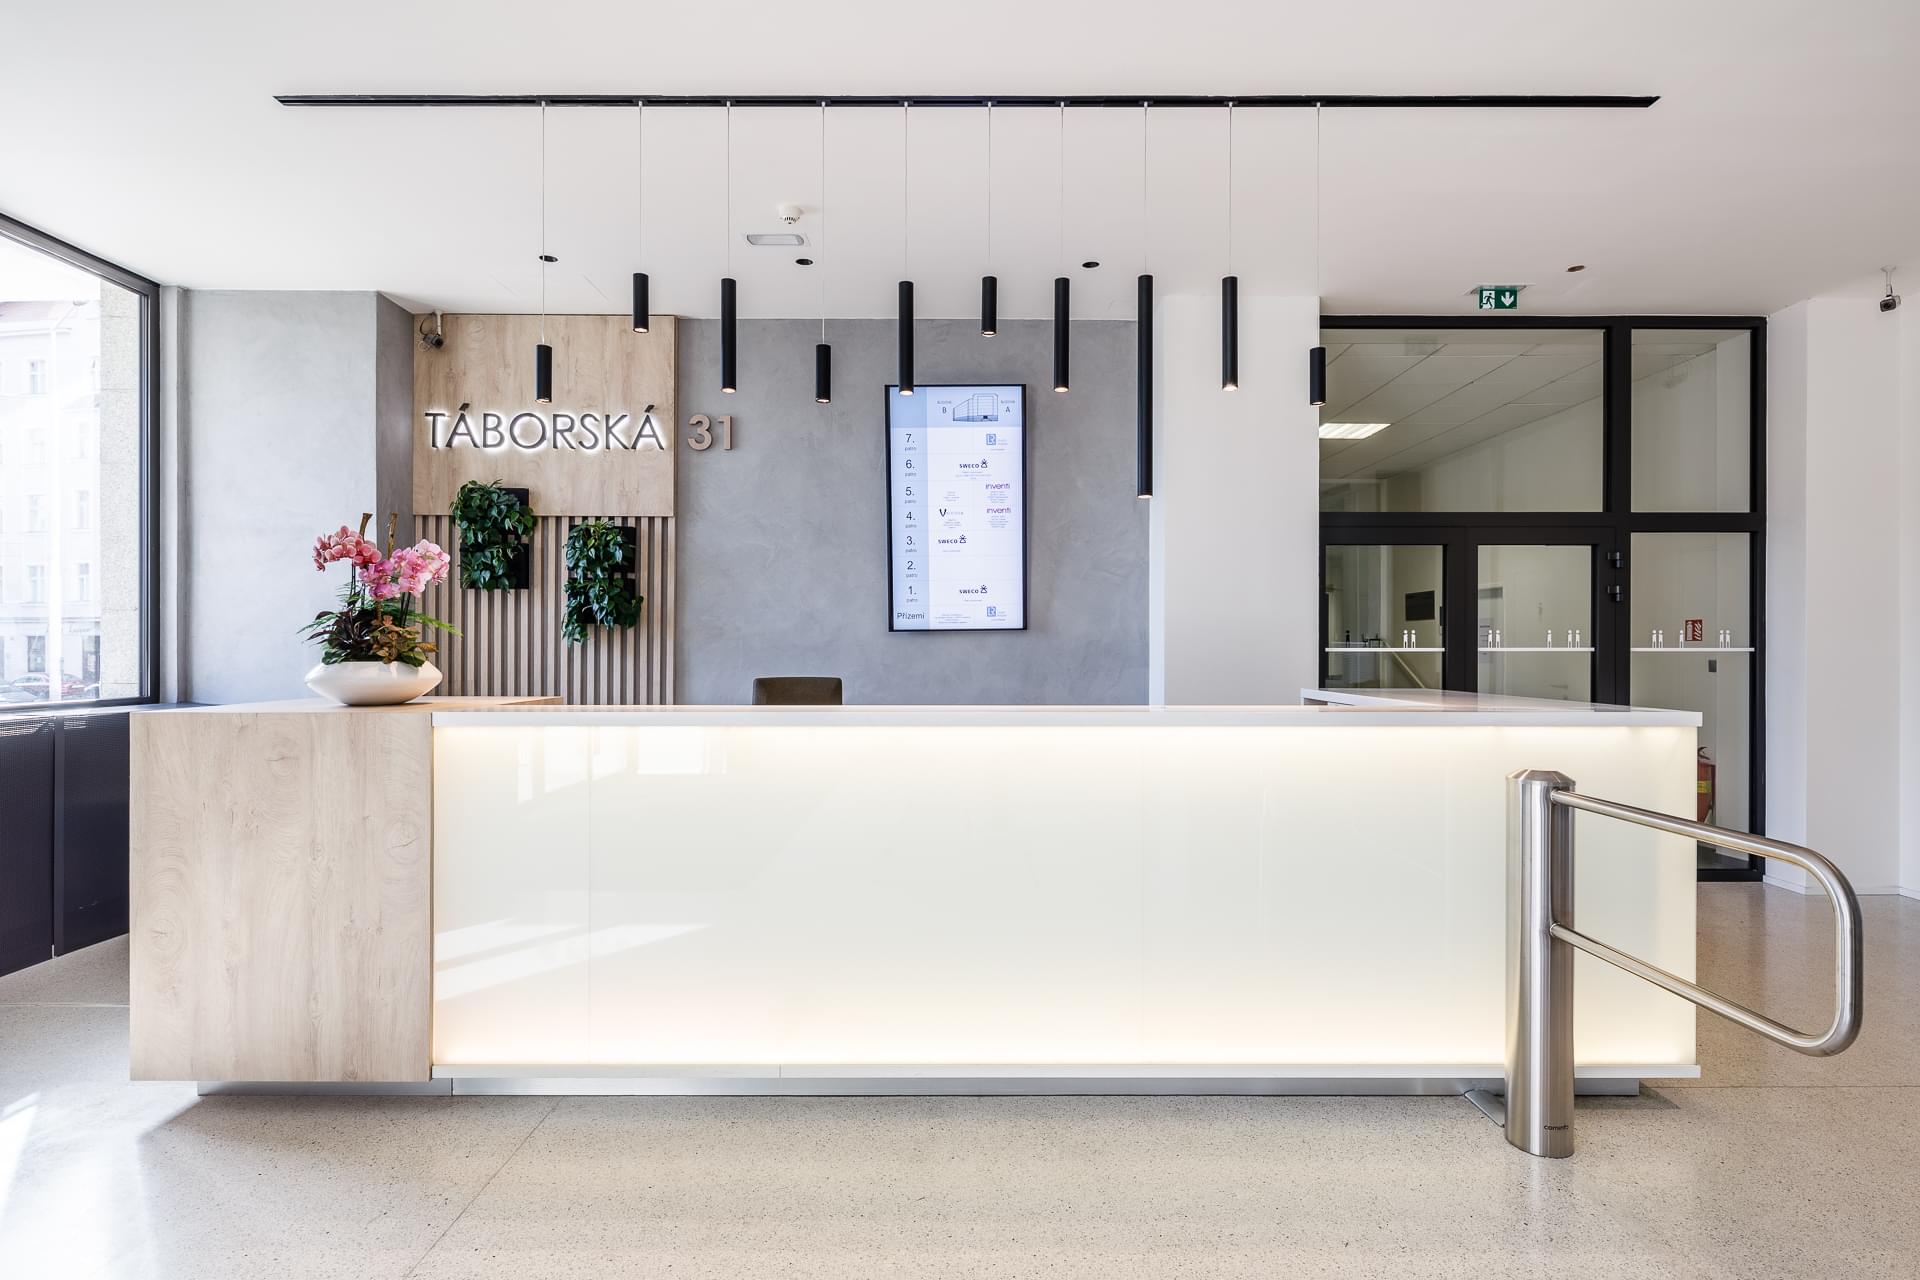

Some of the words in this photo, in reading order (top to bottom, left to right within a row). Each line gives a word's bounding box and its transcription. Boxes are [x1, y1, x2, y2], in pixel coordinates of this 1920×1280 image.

[424, 402, 665, 451] TÁBORSKÁ
[687, 414, 733, 451] 31
[905, 433, 915, 443] 7.
[905, 459, 915, 469] 6.
[905, 486, 915, 496] 5.
[906, 511, 916, 521] 4.
[906, 535, 916, 545] 3.
[907, 560, 916, 570] 2.
[908, 585, 917, 595] 1.
